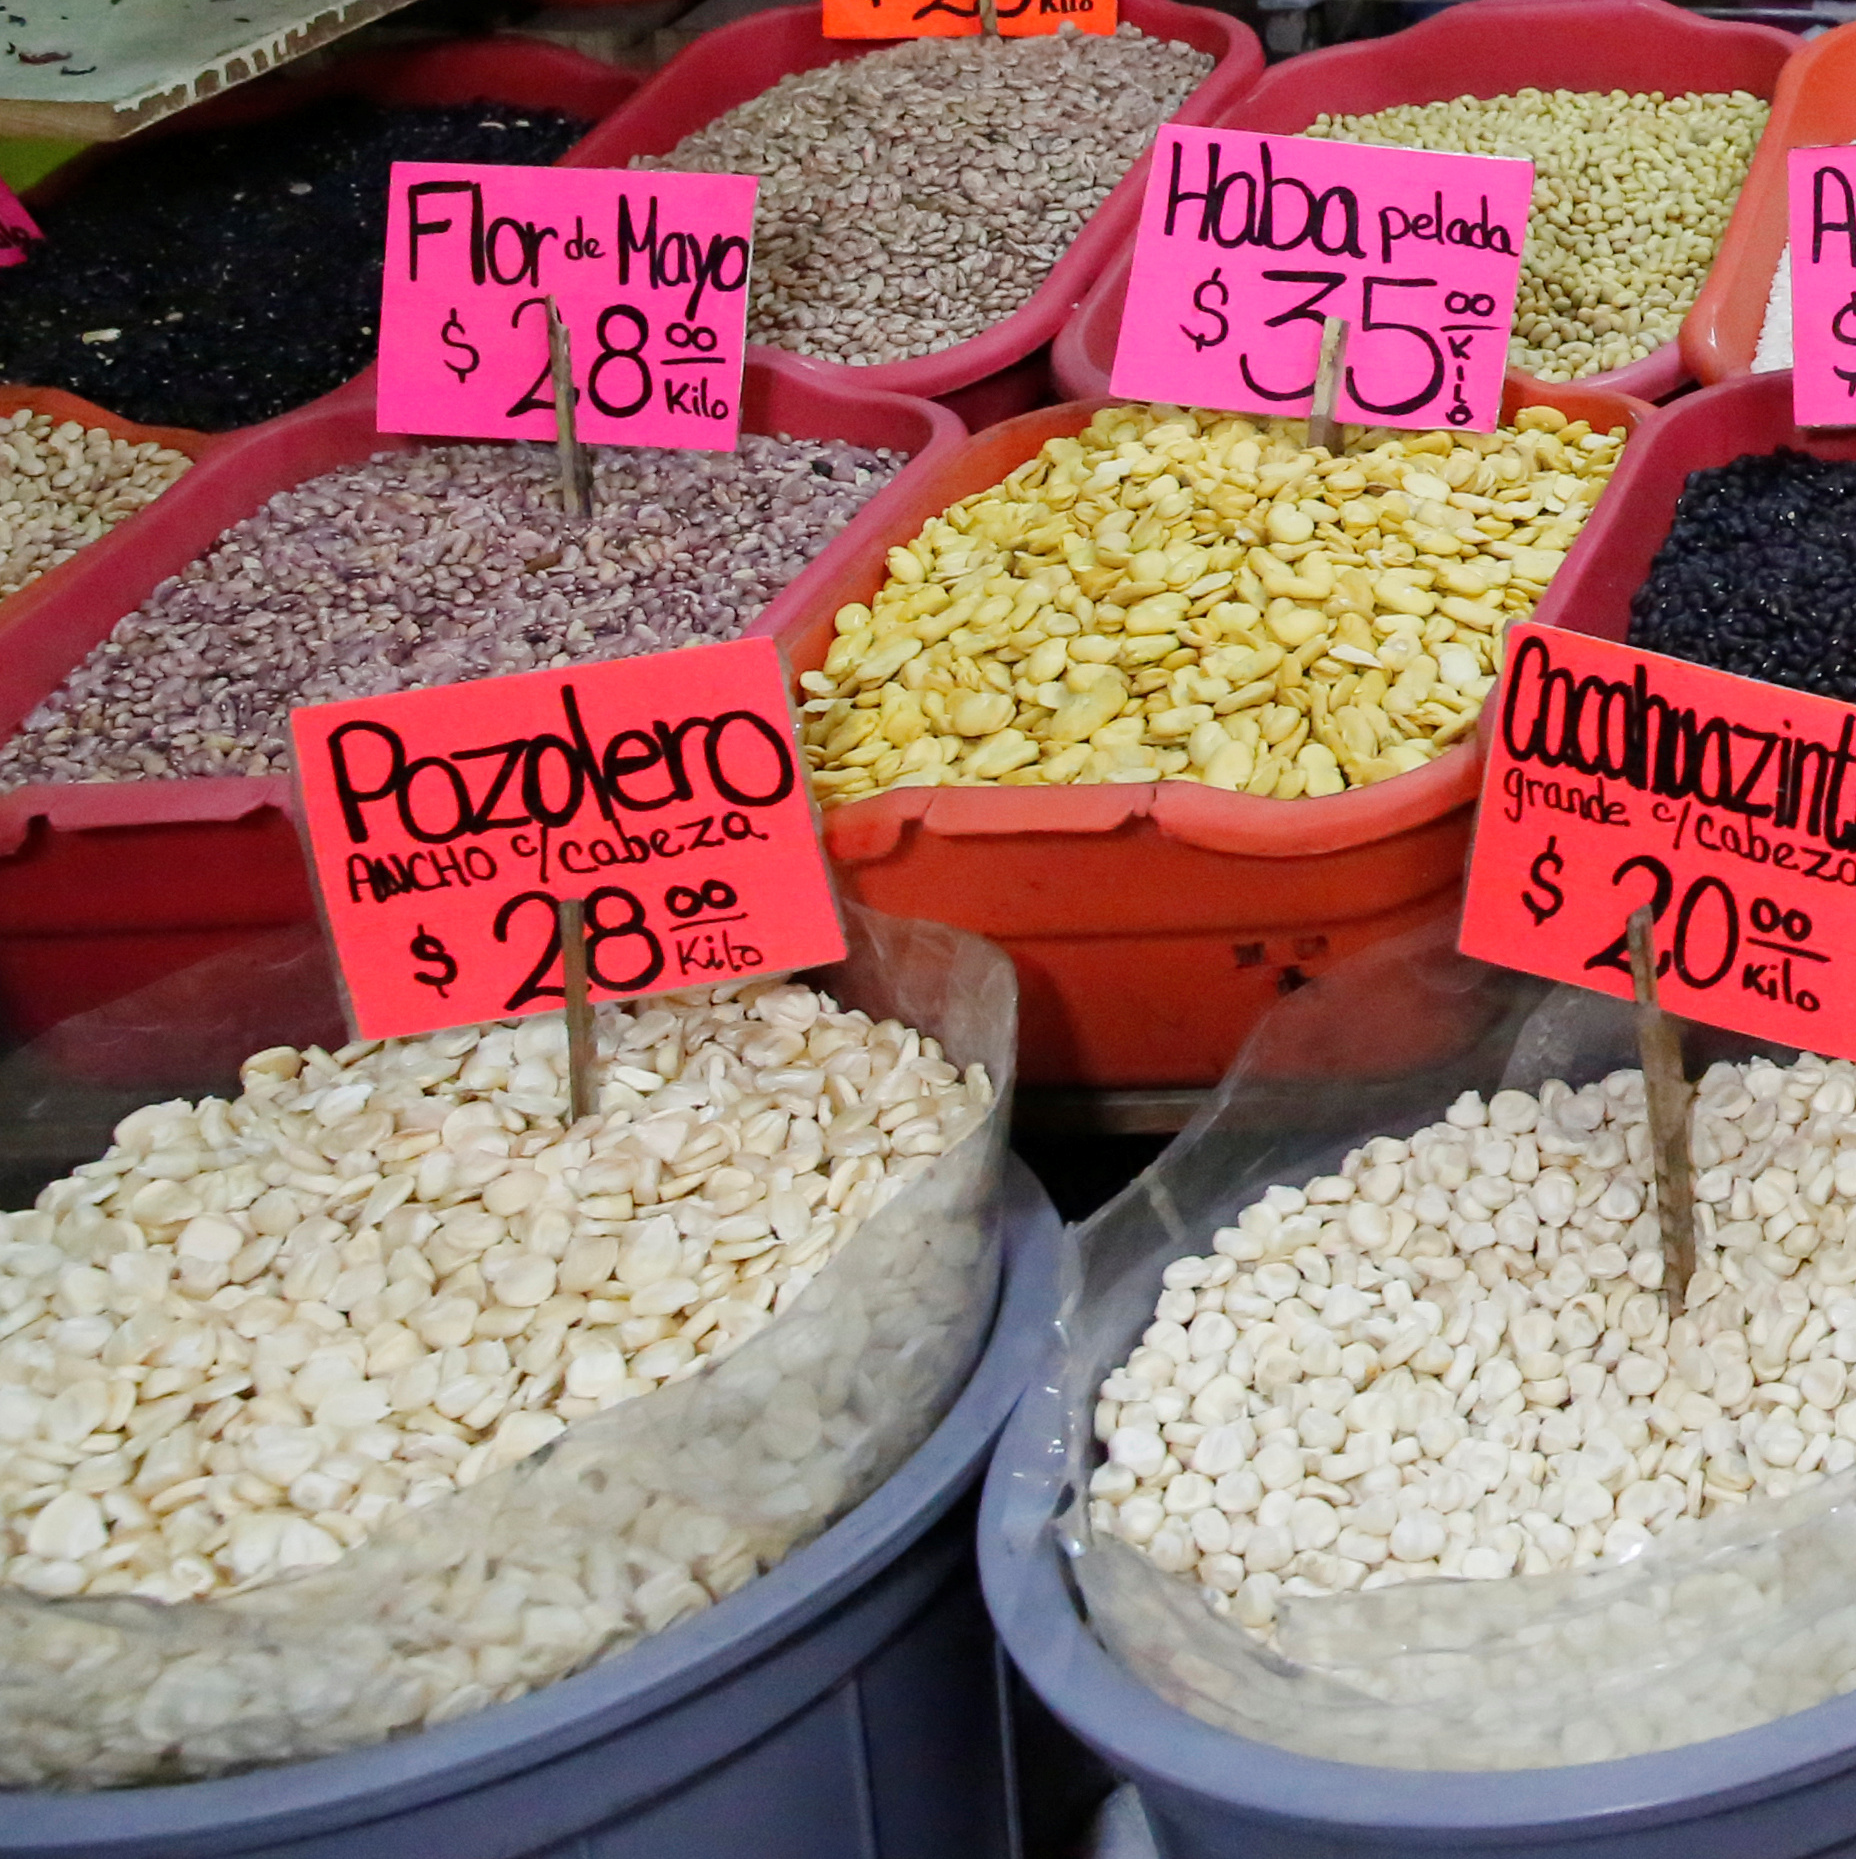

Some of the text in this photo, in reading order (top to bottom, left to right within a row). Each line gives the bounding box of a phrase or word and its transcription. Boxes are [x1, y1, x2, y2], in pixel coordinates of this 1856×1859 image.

[1164, 140, 1521, 264] Haba pelada
[407, 181, 750, 323] Flor de Mayo
[440, 310, 480, 385] $
[665, 320, 718, 354] 00
[1179, 267, 1496, 416] $ 35 00
[664, 379, 730, 422] Kilo
[1503, 767, 1632, 827] grande
[493, 878, 739, 1012] 28 00
[675, 930, 765, 976] Kilo
[1584, 854, 1814, 990] 20 00
[1741, 963, 1821, 1012] Kilo
